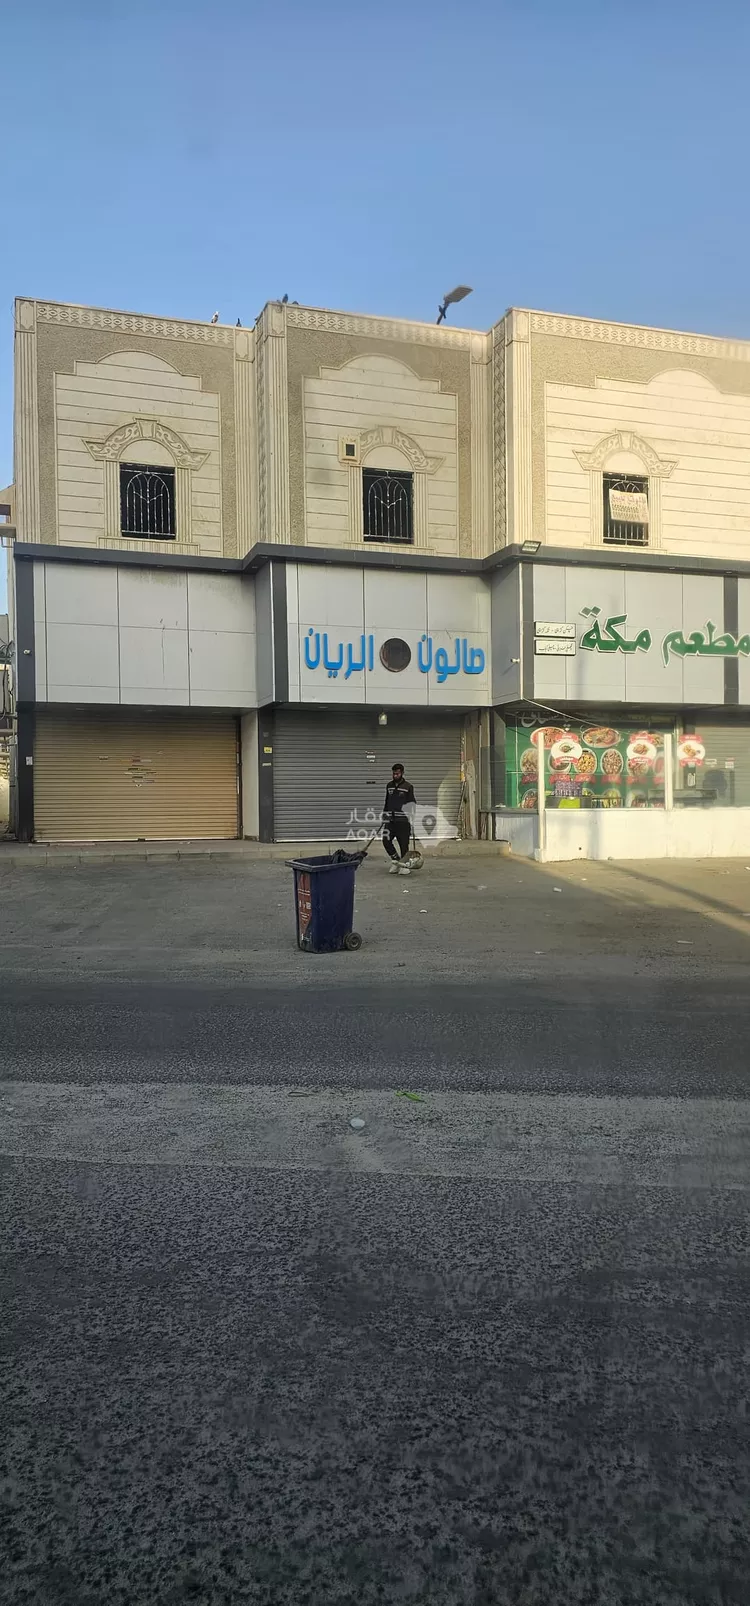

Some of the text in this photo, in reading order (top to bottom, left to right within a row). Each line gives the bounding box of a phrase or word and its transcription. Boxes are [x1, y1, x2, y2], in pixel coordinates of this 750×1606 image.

[304, 627, 485, 683] صالون الريان
[579, 606, 750, 668] مطعم مكة
